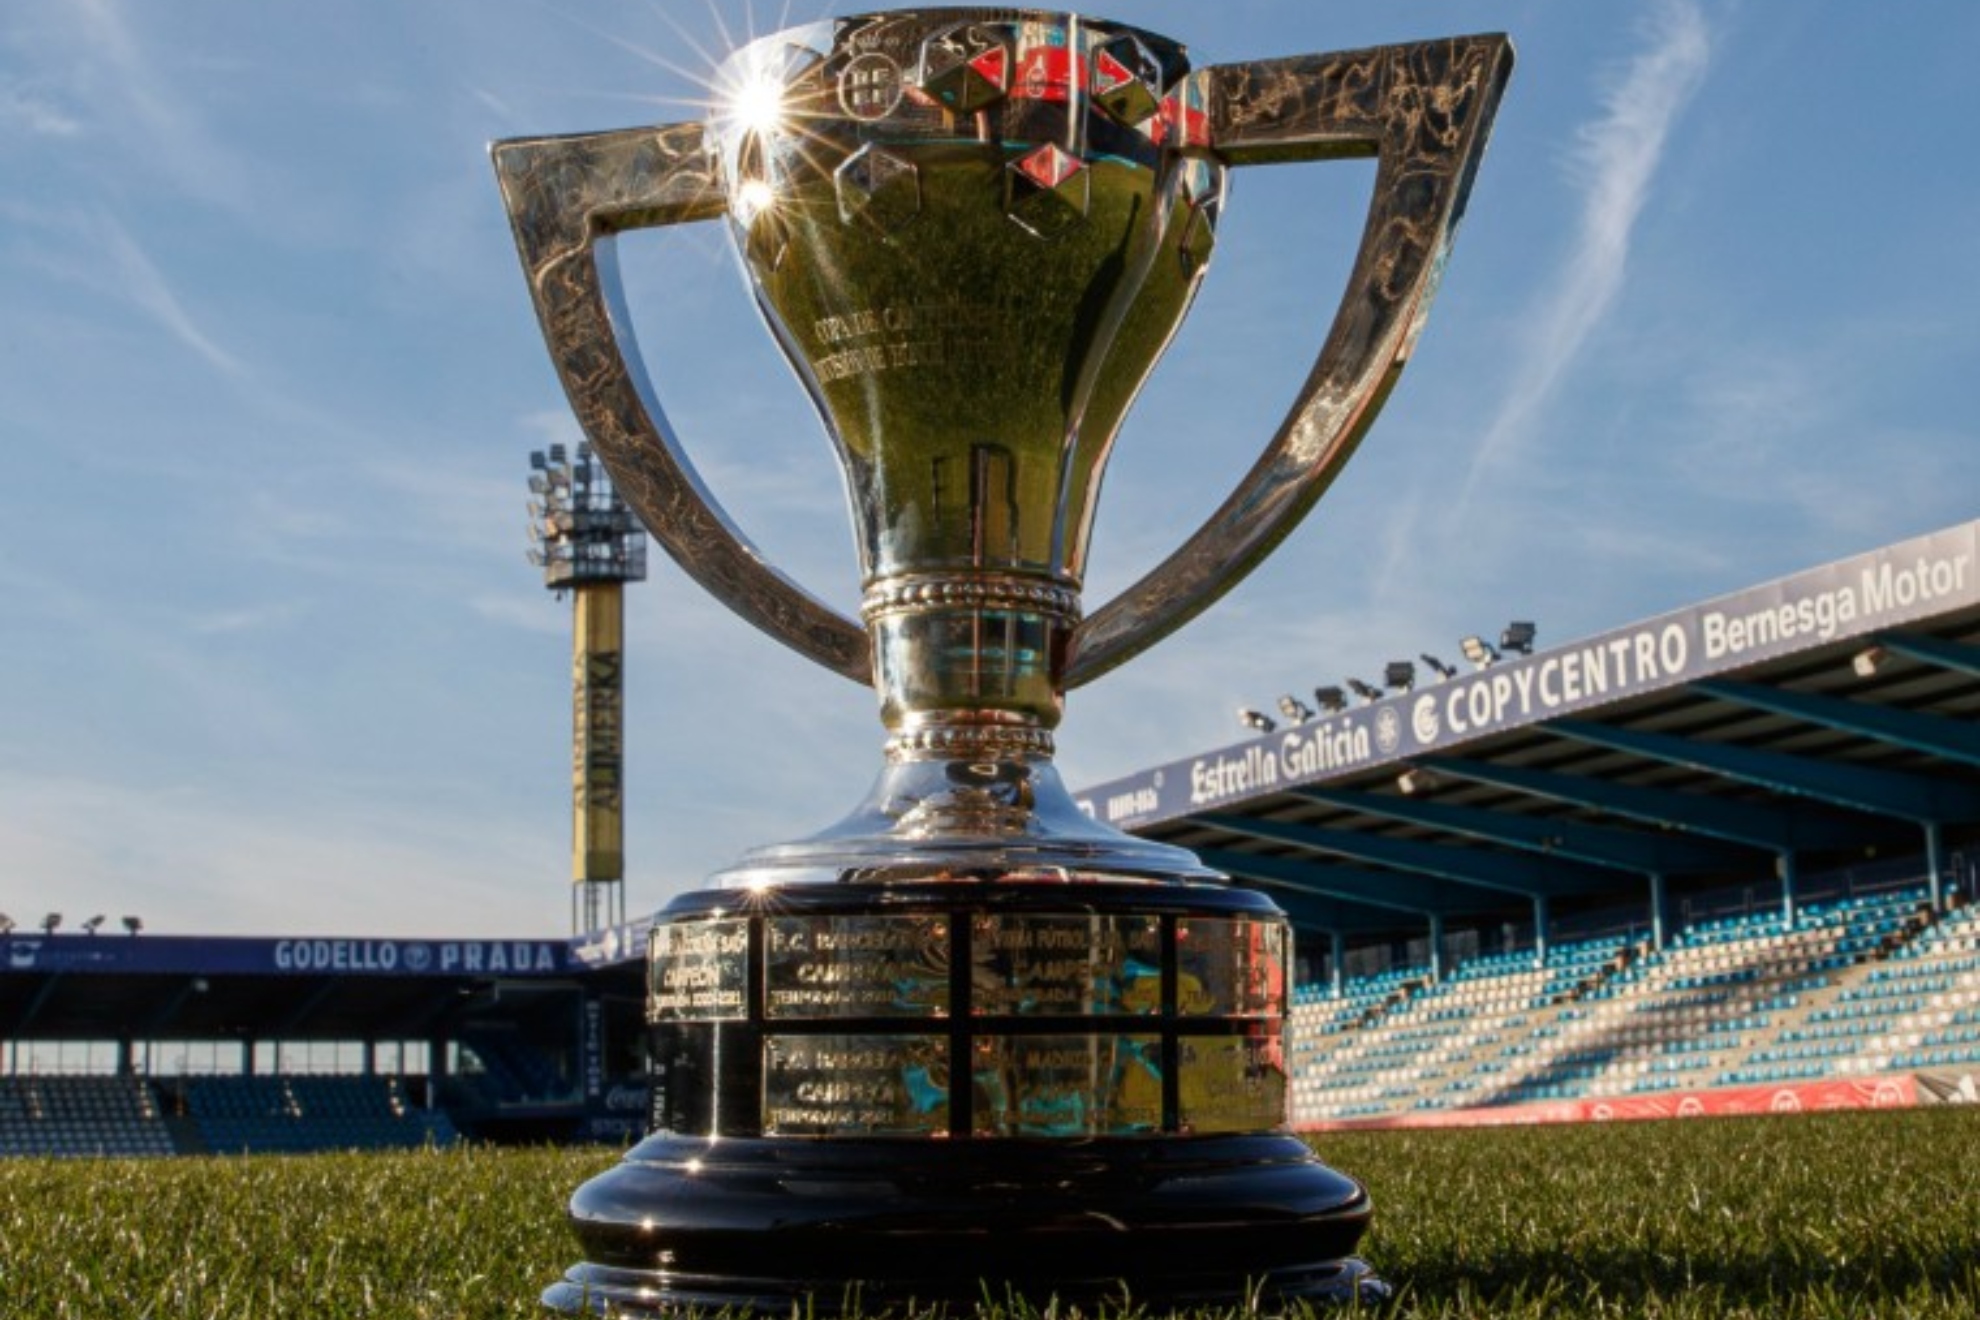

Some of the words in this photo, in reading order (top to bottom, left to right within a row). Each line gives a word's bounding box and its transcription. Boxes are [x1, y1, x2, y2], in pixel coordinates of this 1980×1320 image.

[1702, 585, 1857, 660] Bernesga
[1861, 553, 1970, 615] Motor
[1446, 622, 1688, 734] COPYCENTRO
[1190, 745, 1278, 804] Estrella
[1281, 716, 1370, 781] Galicia
[275, 940, 398, 970] GODELLO
[439, 943, 555, 971] PRADA
